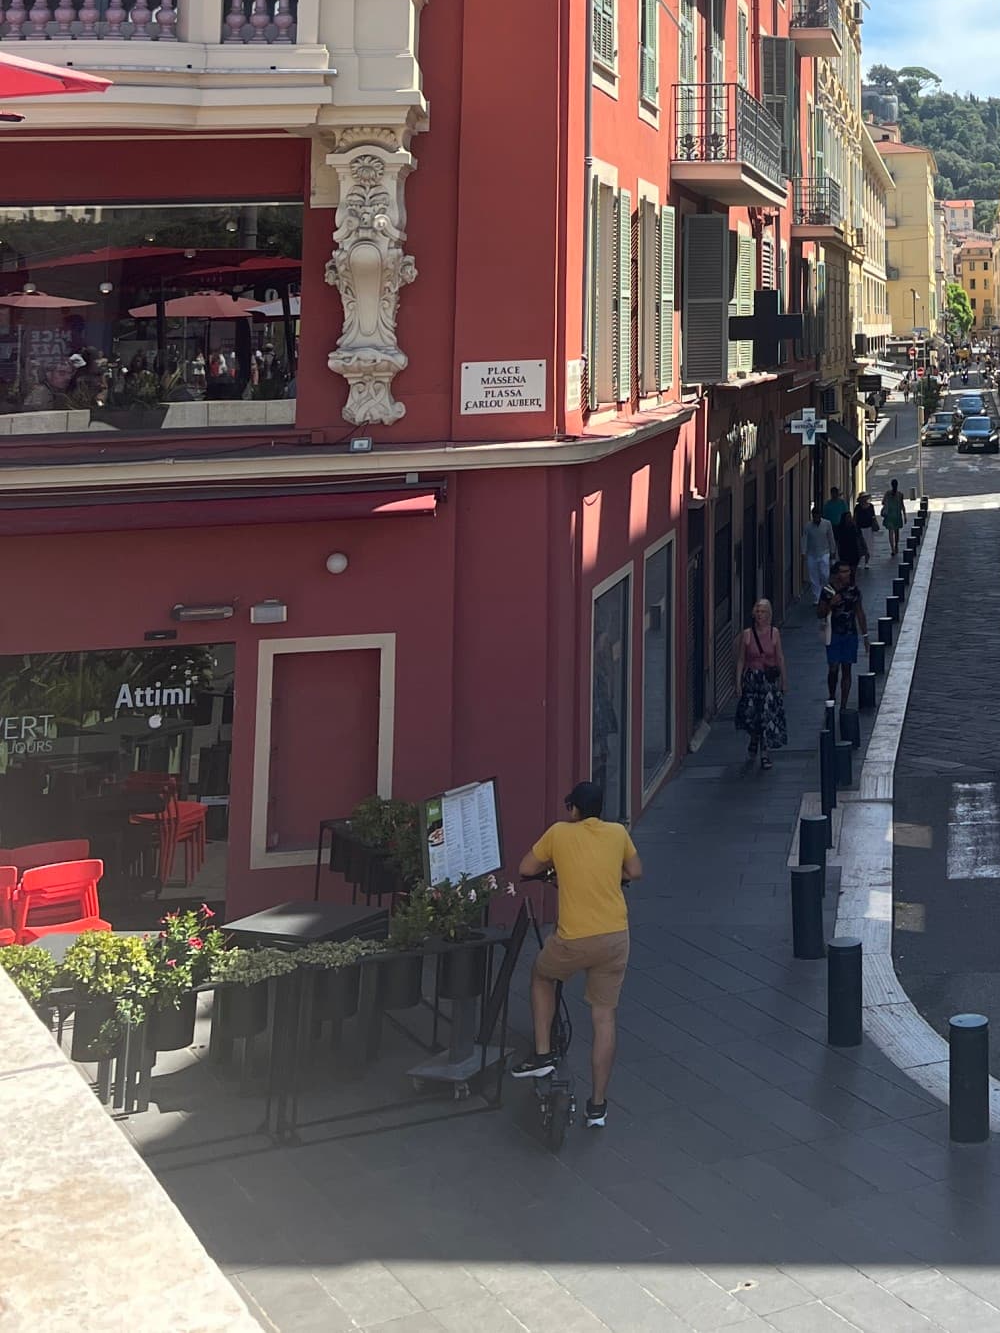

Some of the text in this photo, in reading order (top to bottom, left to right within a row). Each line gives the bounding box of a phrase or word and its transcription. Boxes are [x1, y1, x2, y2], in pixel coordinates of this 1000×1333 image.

[487, 366, 521, 375] PLACE
[480, 375, 527, 385] MASSENA
[484, 389, 522, 398] PLASSA
[466, 398, 541, 409] CARLOU AUBERT
[115, 680, 192, 709] Attimi
